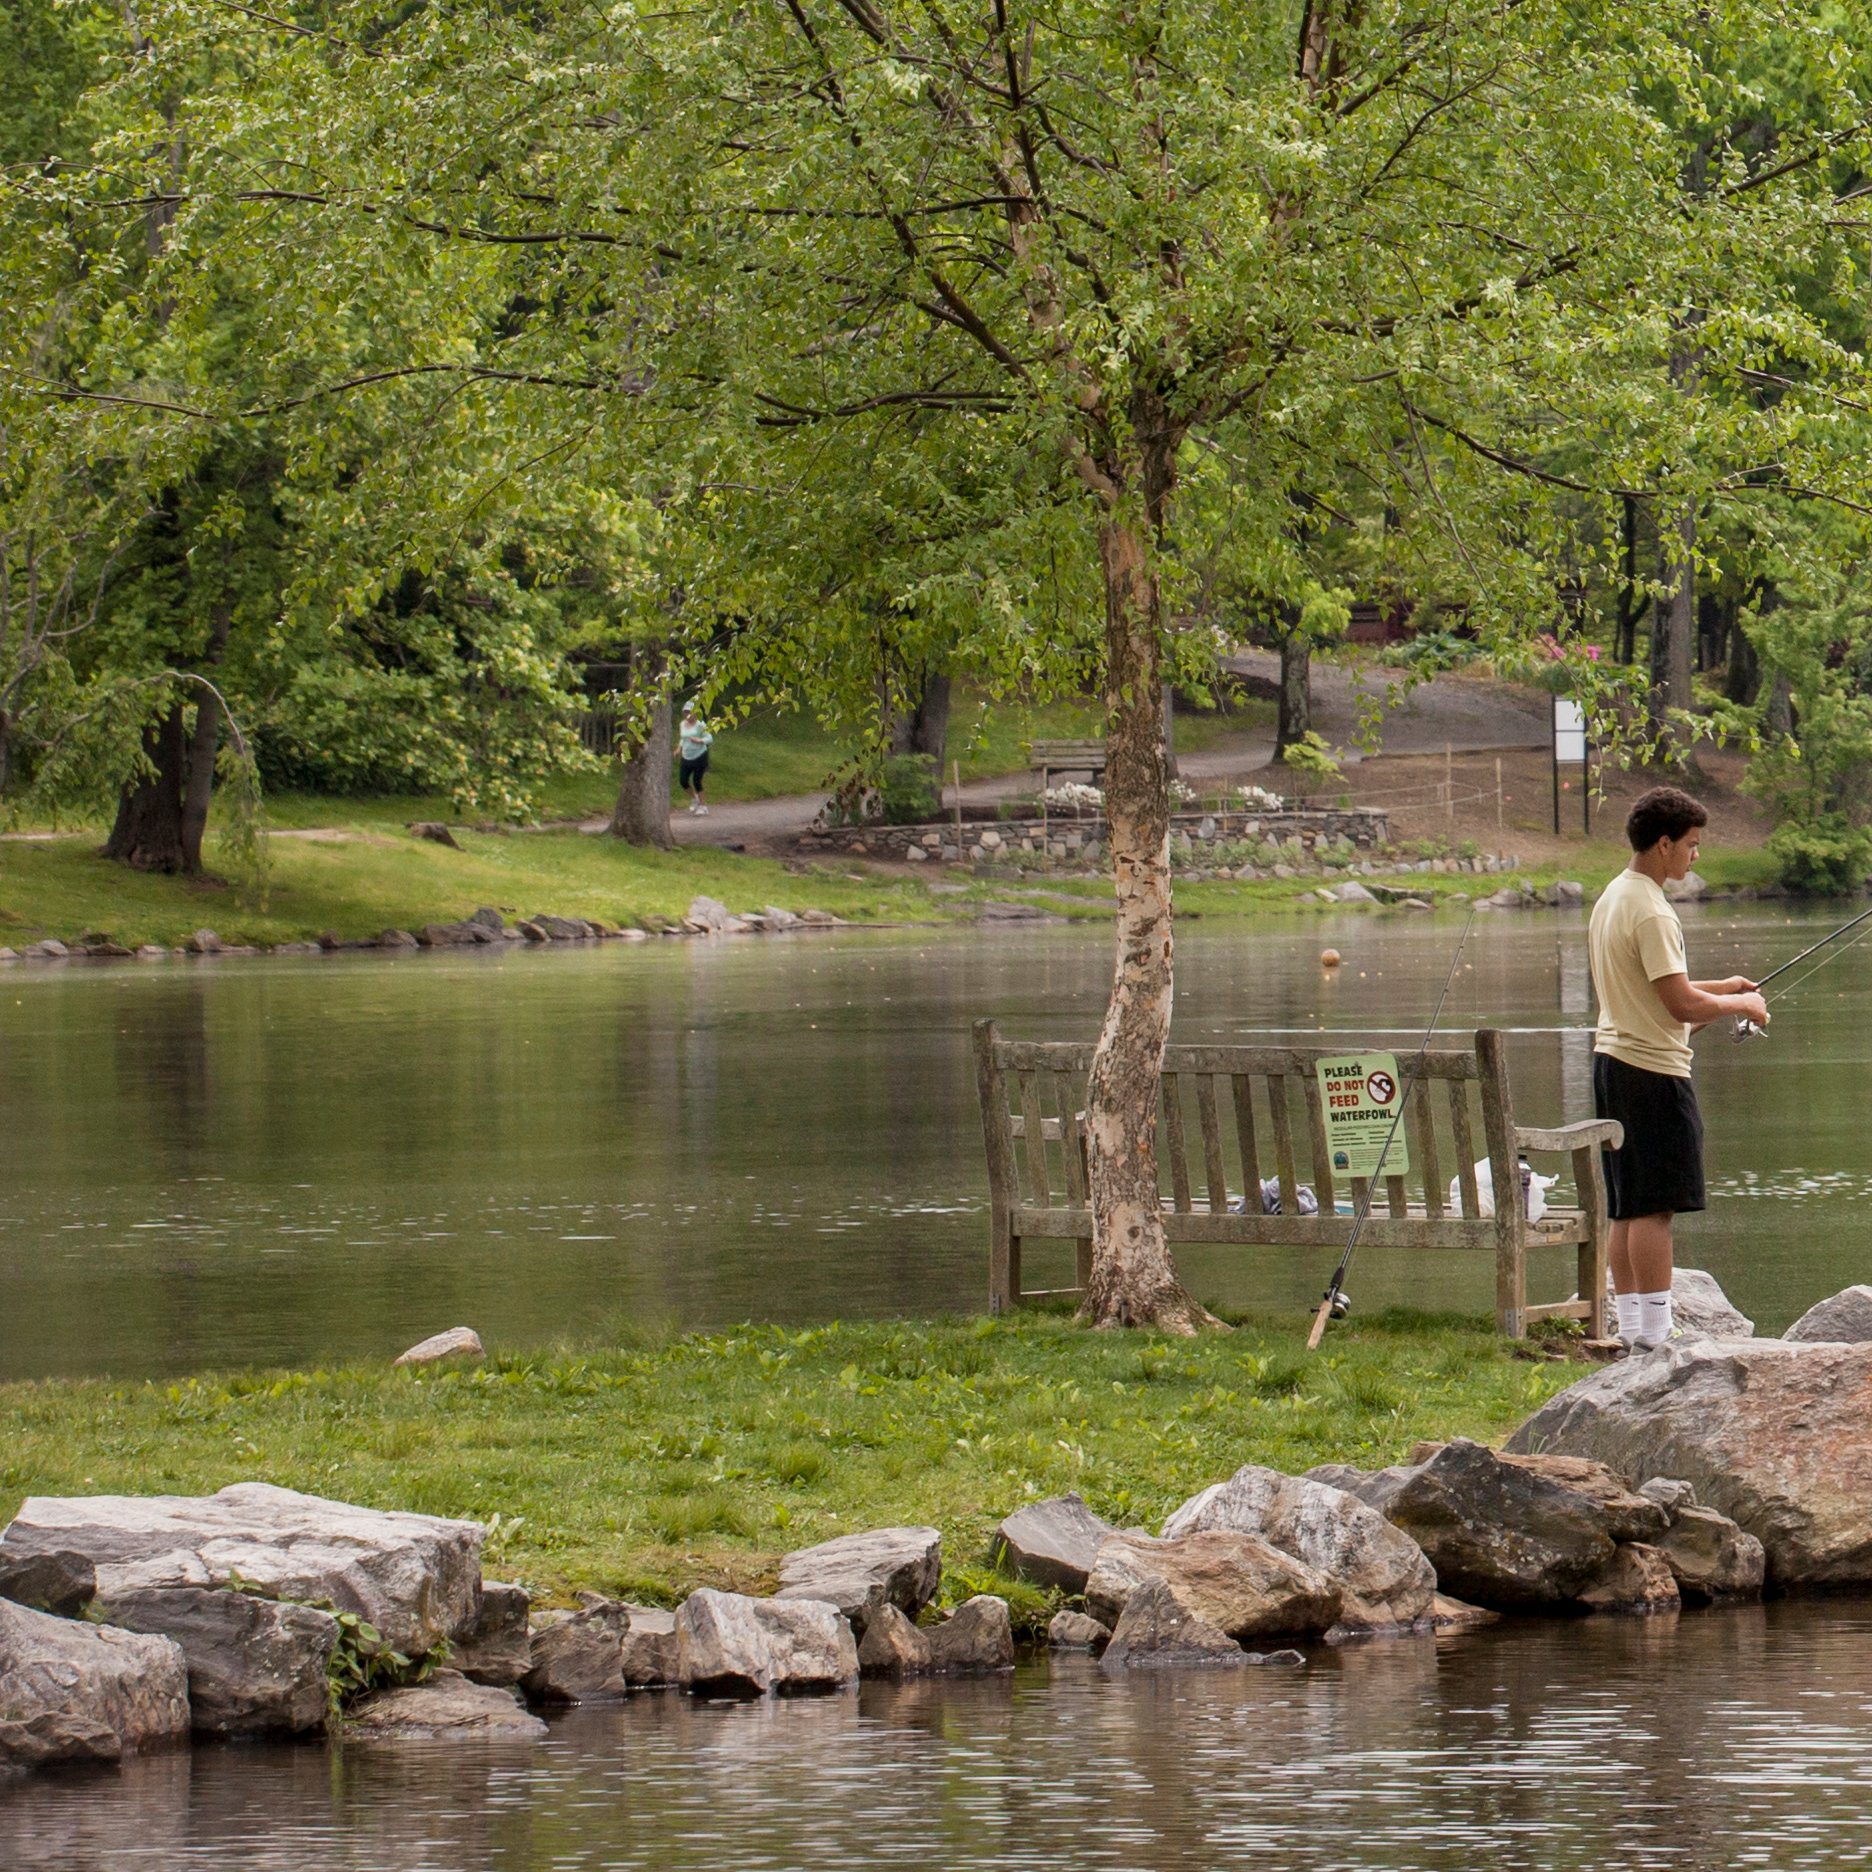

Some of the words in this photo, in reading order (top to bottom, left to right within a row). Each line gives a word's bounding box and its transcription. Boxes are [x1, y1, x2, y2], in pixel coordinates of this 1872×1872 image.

[1324, 1066, 1363, 1078] PLEASE
[1327, 1081, 1341, 1092] DO
[1345, 1080, 1364, 1091] NOT
[1329, 1094, 1359, 1108] FEED
